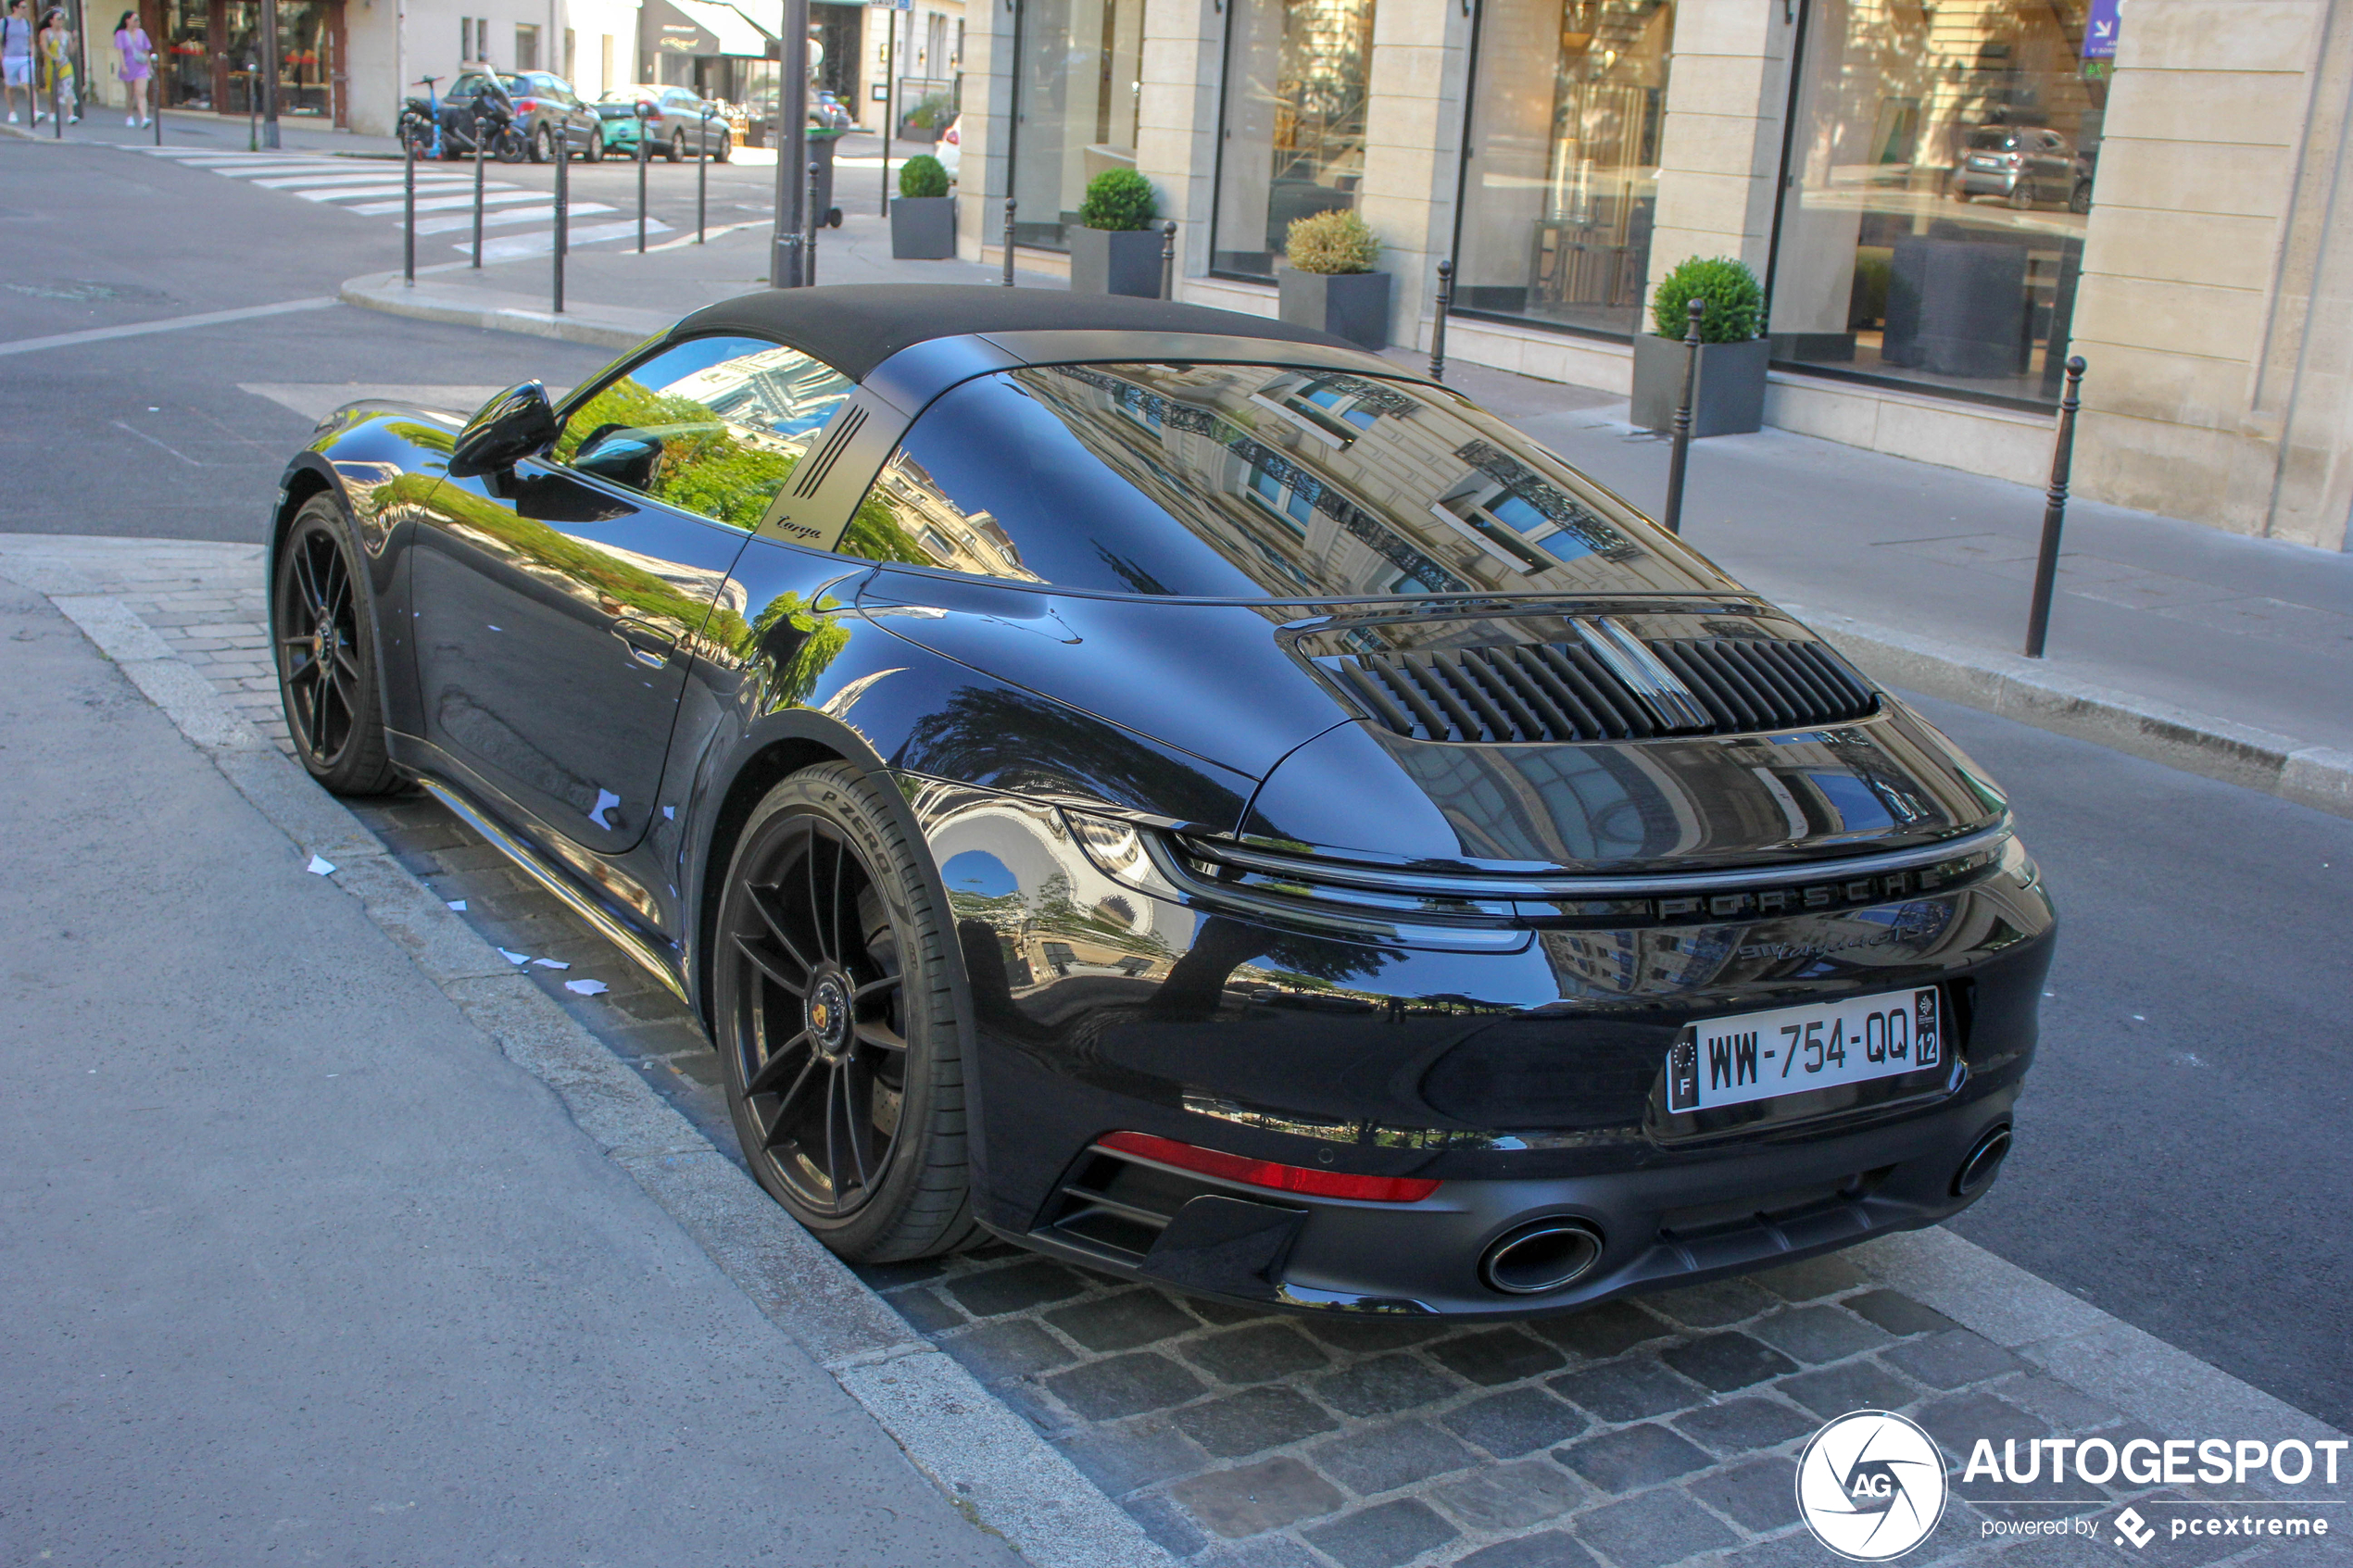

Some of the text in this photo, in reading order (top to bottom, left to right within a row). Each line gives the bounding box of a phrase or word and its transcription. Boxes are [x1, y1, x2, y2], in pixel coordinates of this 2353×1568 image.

[775, 515, 822, 539] targa
[821, 790, 892, 875] P ZERO
[1659, 870, 1941, 921] PORSCHE
[1680, 1008, 1936, 1096] F WW-754-QQ 12
